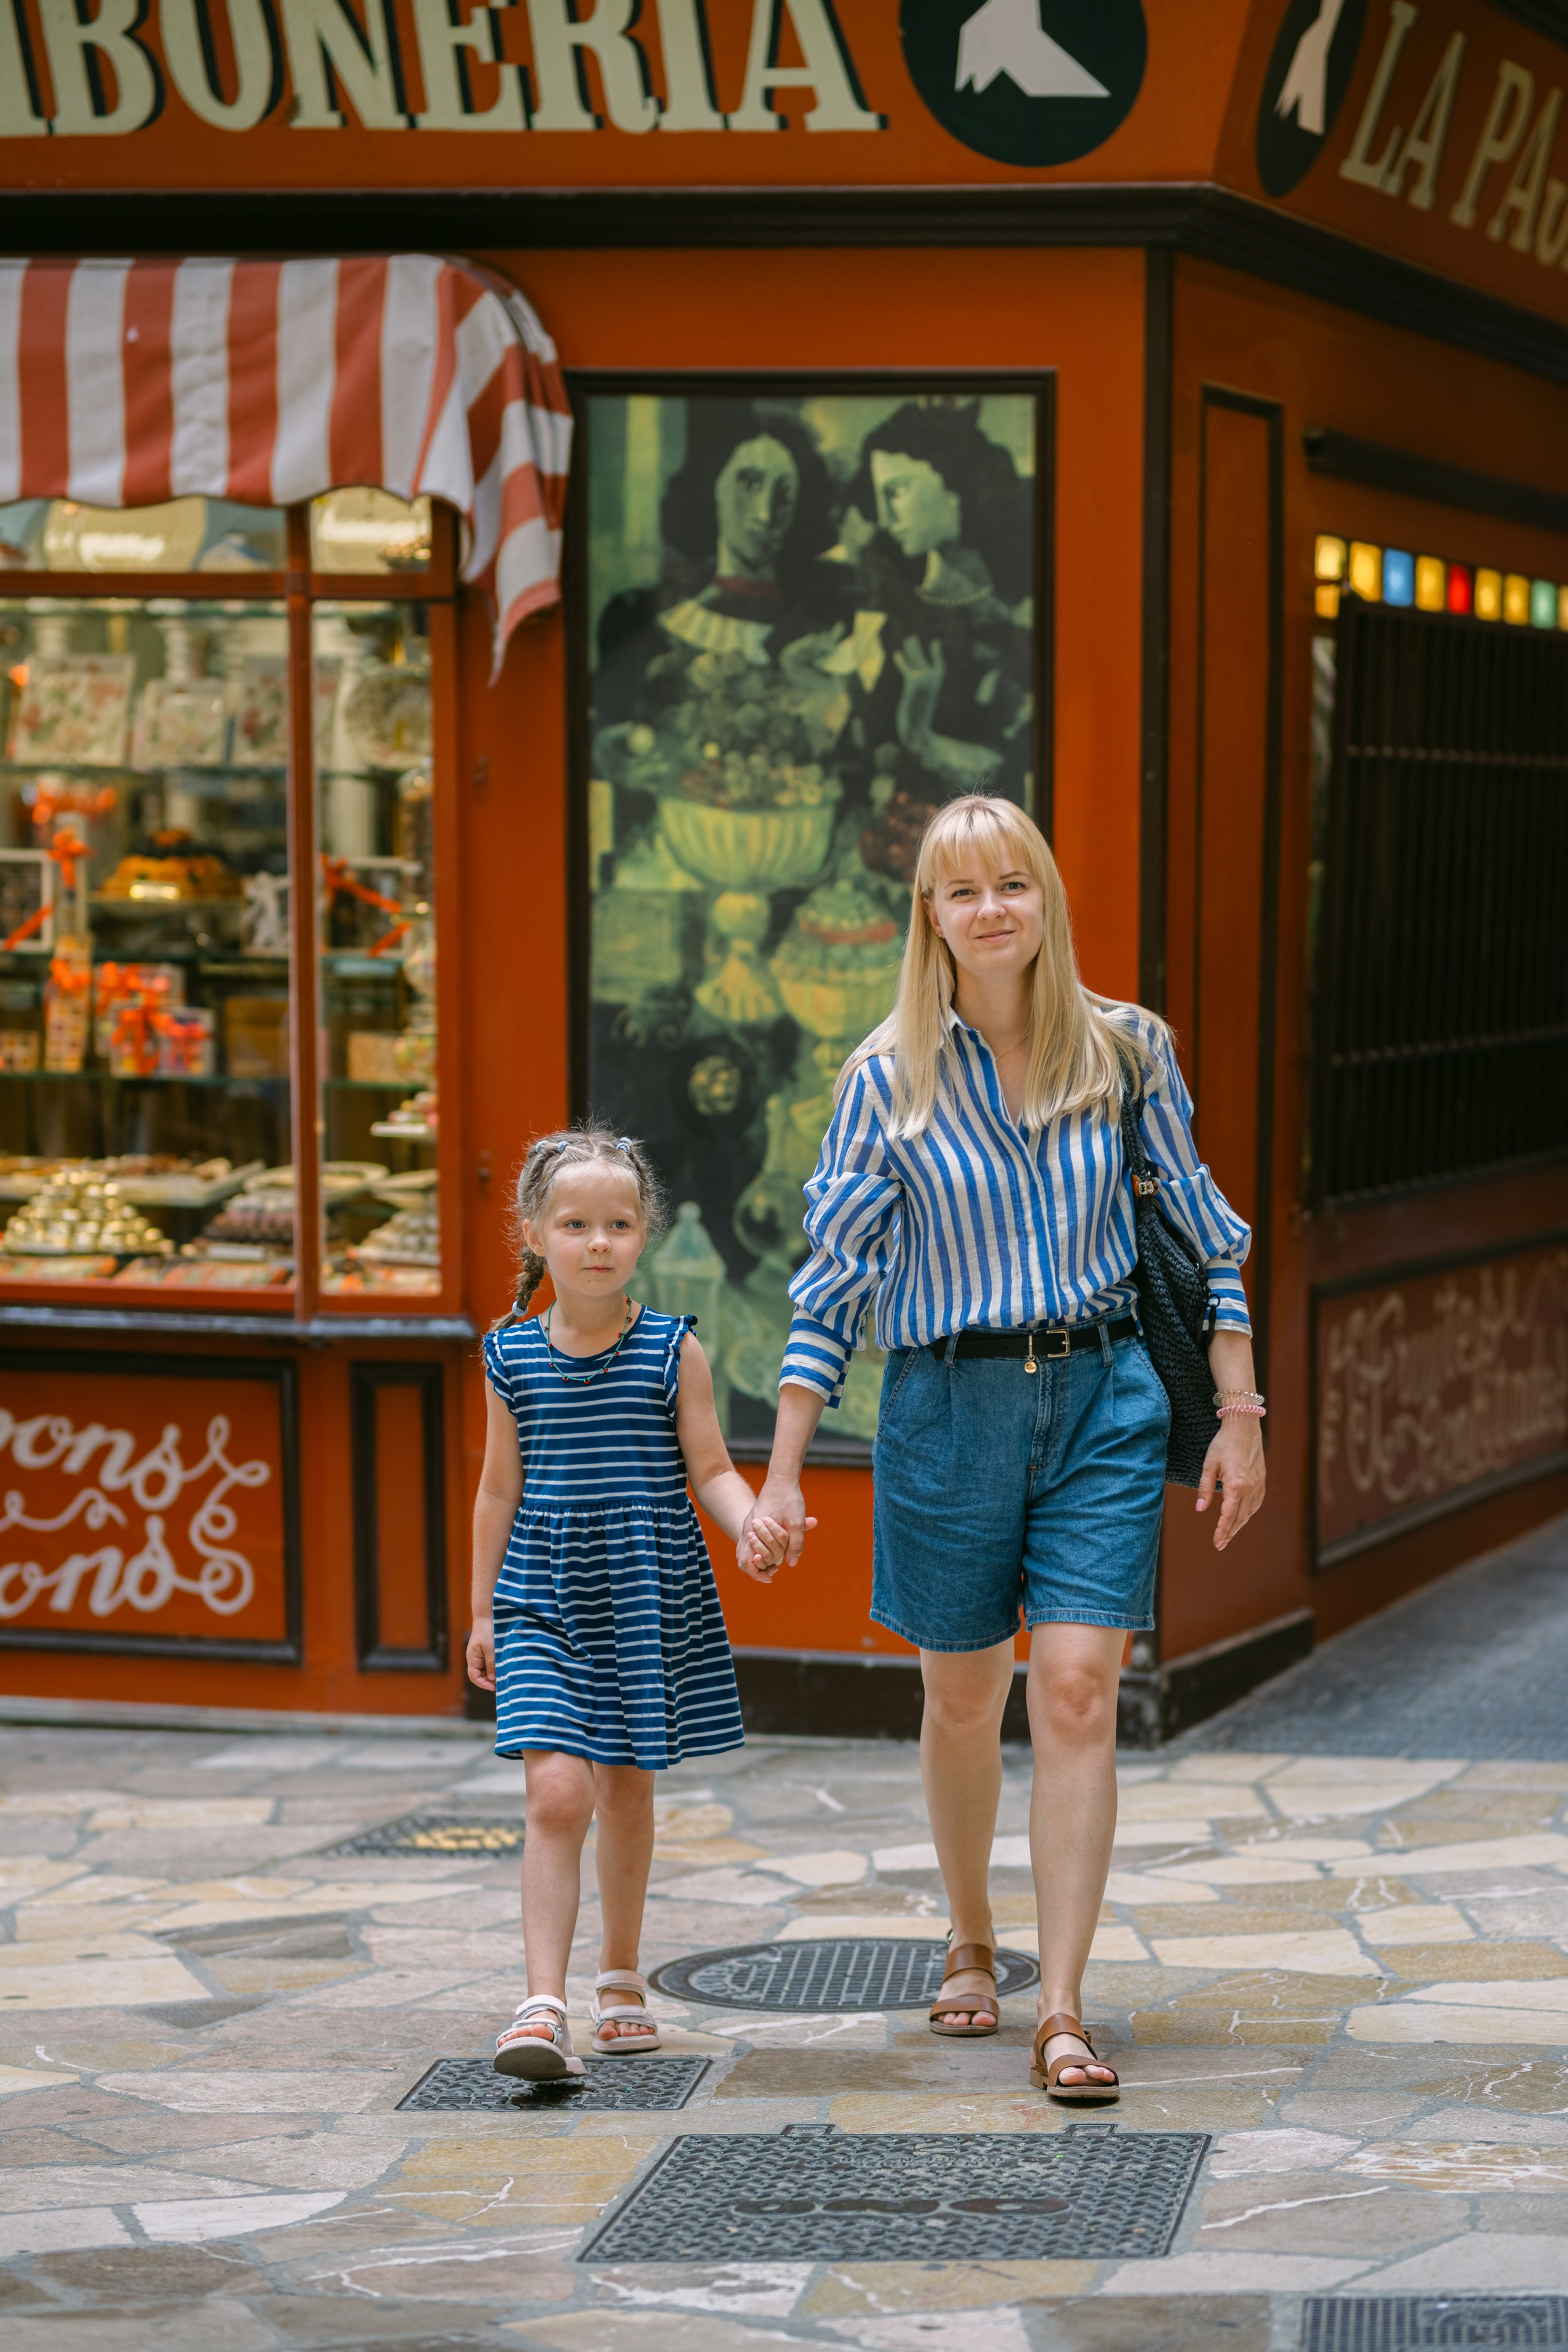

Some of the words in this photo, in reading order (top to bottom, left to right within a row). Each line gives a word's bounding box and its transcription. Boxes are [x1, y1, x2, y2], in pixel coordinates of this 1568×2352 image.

[0, 0, 882, 135] BONERIA
[1338, 0, 1466, 212] LA
[0, 1408, 270, 1511] ons
